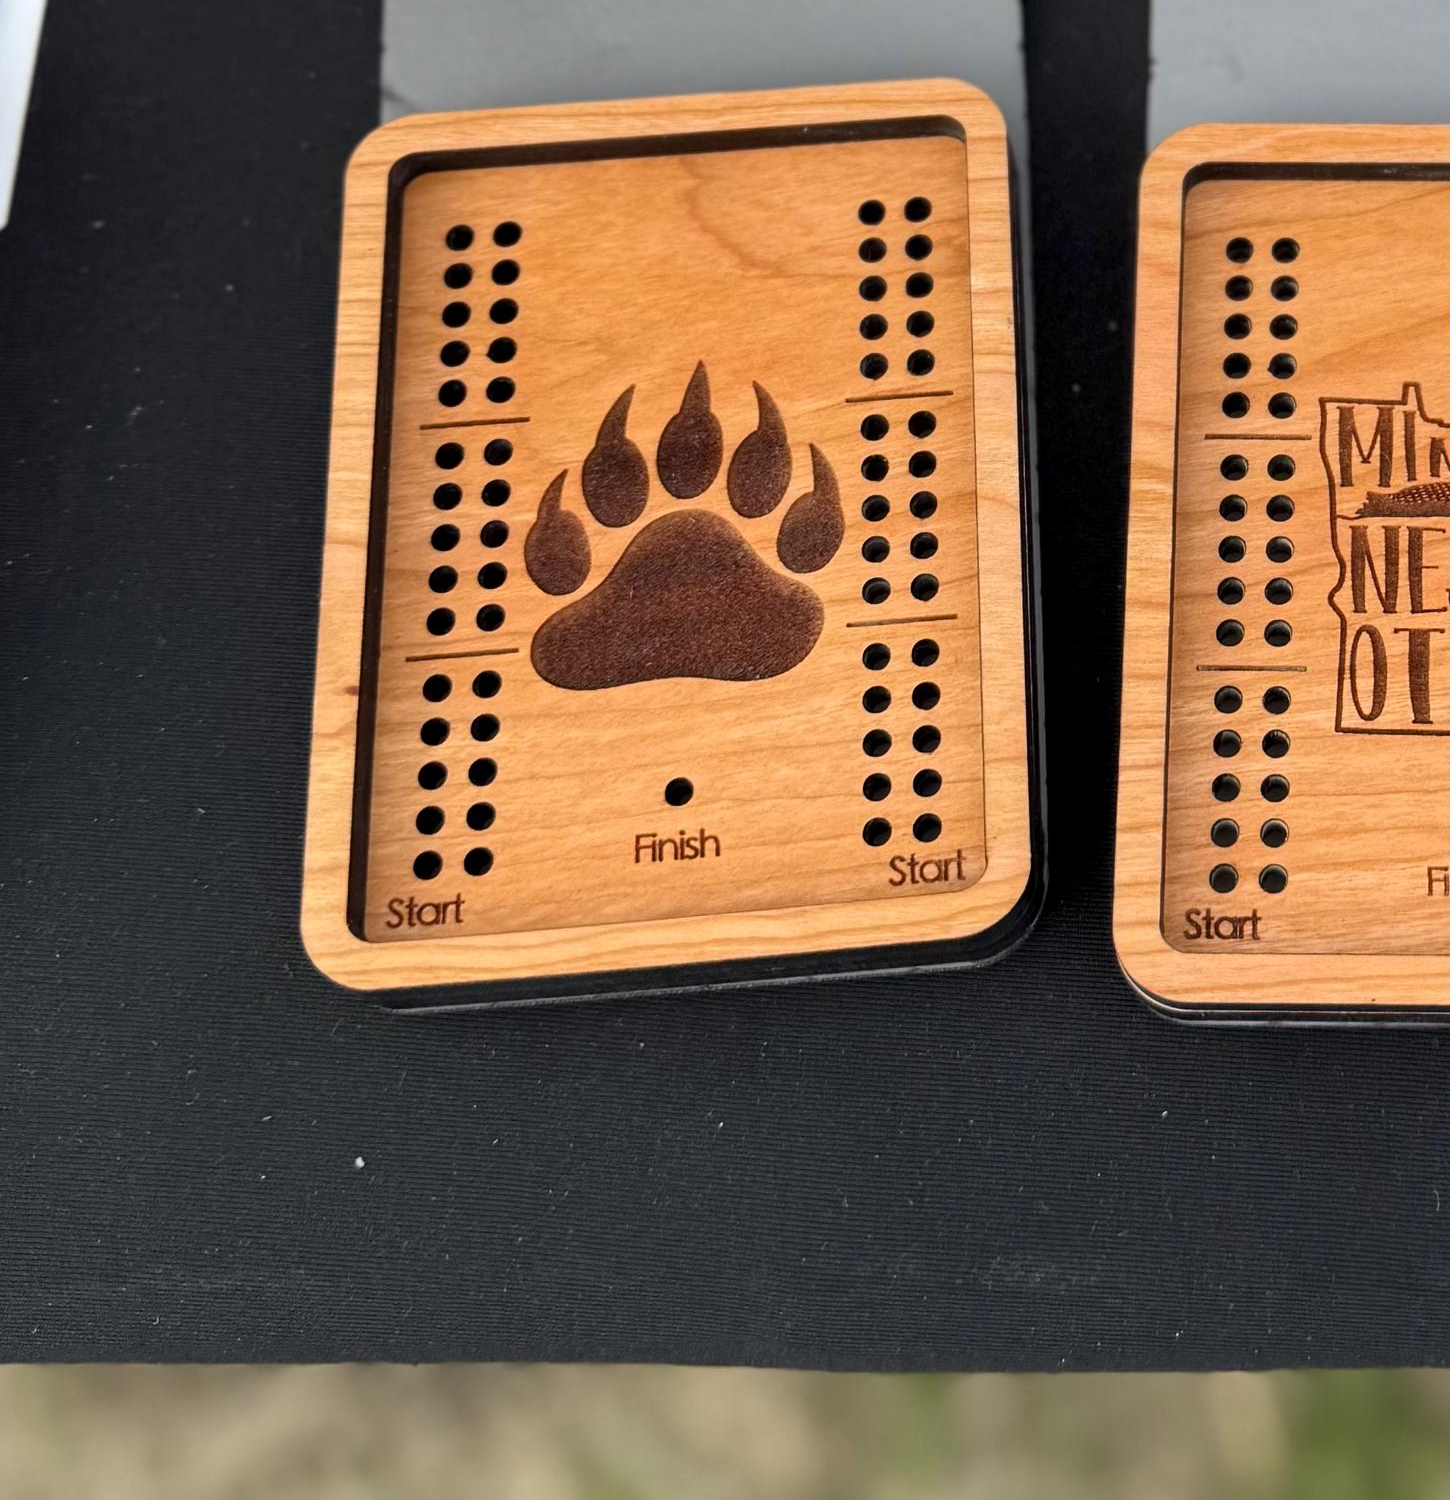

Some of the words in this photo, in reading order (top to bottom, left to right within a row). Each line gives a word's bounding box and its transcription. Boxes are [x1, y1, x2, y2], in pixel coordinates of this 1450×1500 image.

[635, 828, 722, 864] Finish
[889, 849, 966, 887] Start
[385, 892, 466, 929] Start
[1183, 907, 1262, 941] Start
